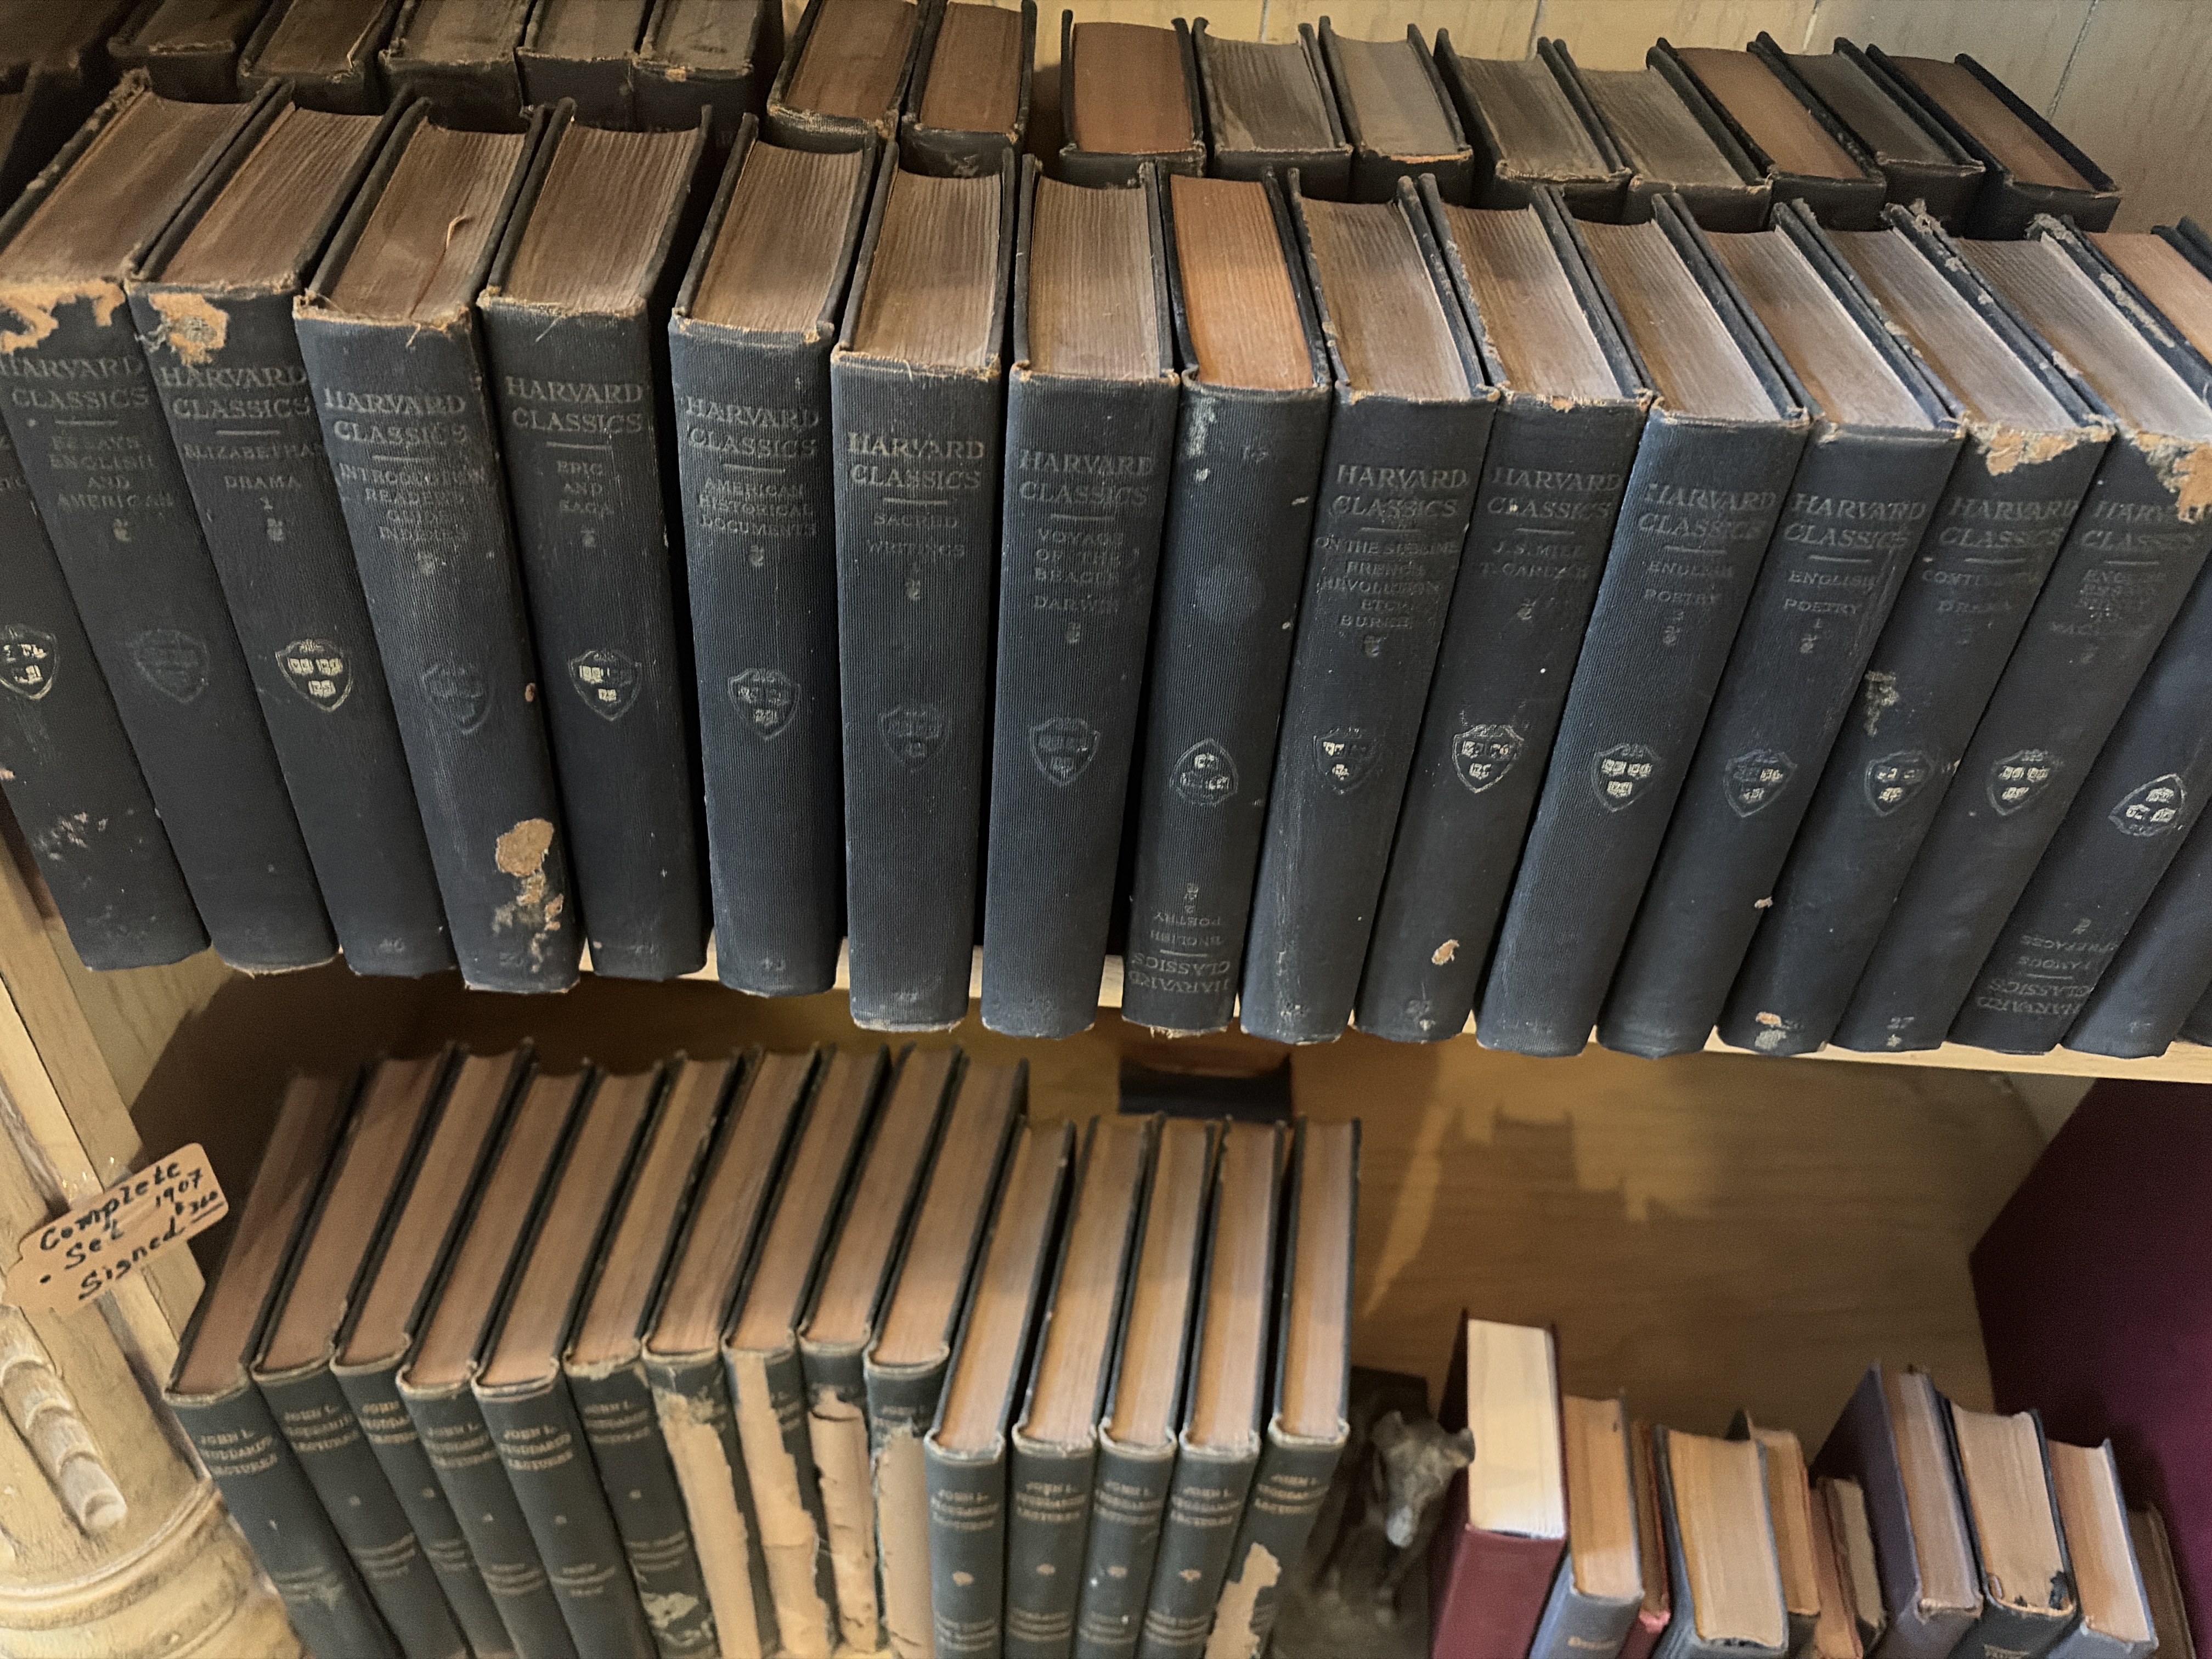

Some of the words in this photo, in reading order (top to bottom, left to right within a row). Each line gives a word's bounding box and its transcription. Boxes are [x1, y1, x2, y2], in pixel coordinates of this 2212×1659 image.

[159, 366, 307, 388] HARVARD
[11, 386, 149, 410] CLASSICS
[505, 376, 643, 404] HARVARD
[172, 395, 311, 420] CLASSICS
[324, 388, 466, 417] HARVARD
[686, 396, 819, 427] HARVARD
[513, 407, 642, 433] CLASSICS
[690, 427, 816, 458] CLASSICS
[848, 431, 984, 460] HARVARD
[48, 453, 155, 471] ENGLISH
[557, 460, 603, 475] EPIC
[1019, 449, 1153, 476] HARVARD
[87, 475, 132, 491] AND
[224, 475, 302, 492] DRAMA
[851, 464, 981, 490] CLASSICS
[1336, 465, 1468, 489] HARVARD
[1491, 467, 1624, 491] HARVARD
[1019, 481, 1149, 506] CLASSICS
[1645, 483, 1777, 510] HARVARD
[1331, 495, 1458, 518] CLASSICS
[1792, 493, 1927, 520] HARVARD
[1949, 496, 2080, 520] HARVARD
[1316, 535, 1340, 551] ON
[1346, 540, 1379, 554] THE
[1785, 523, 1909, 549] CLASSICS
[1131, 952, 1231, 976] CLASSICS
[1128, 970, 1230, 994] HARVARD
[1989, 978, 2094, 997] CLASSICS
[1977, 996, 2083, 1015] HARVARD
[64, 1218, 124, 1270] Set
[78, 1216, 187, 1301] Signed
